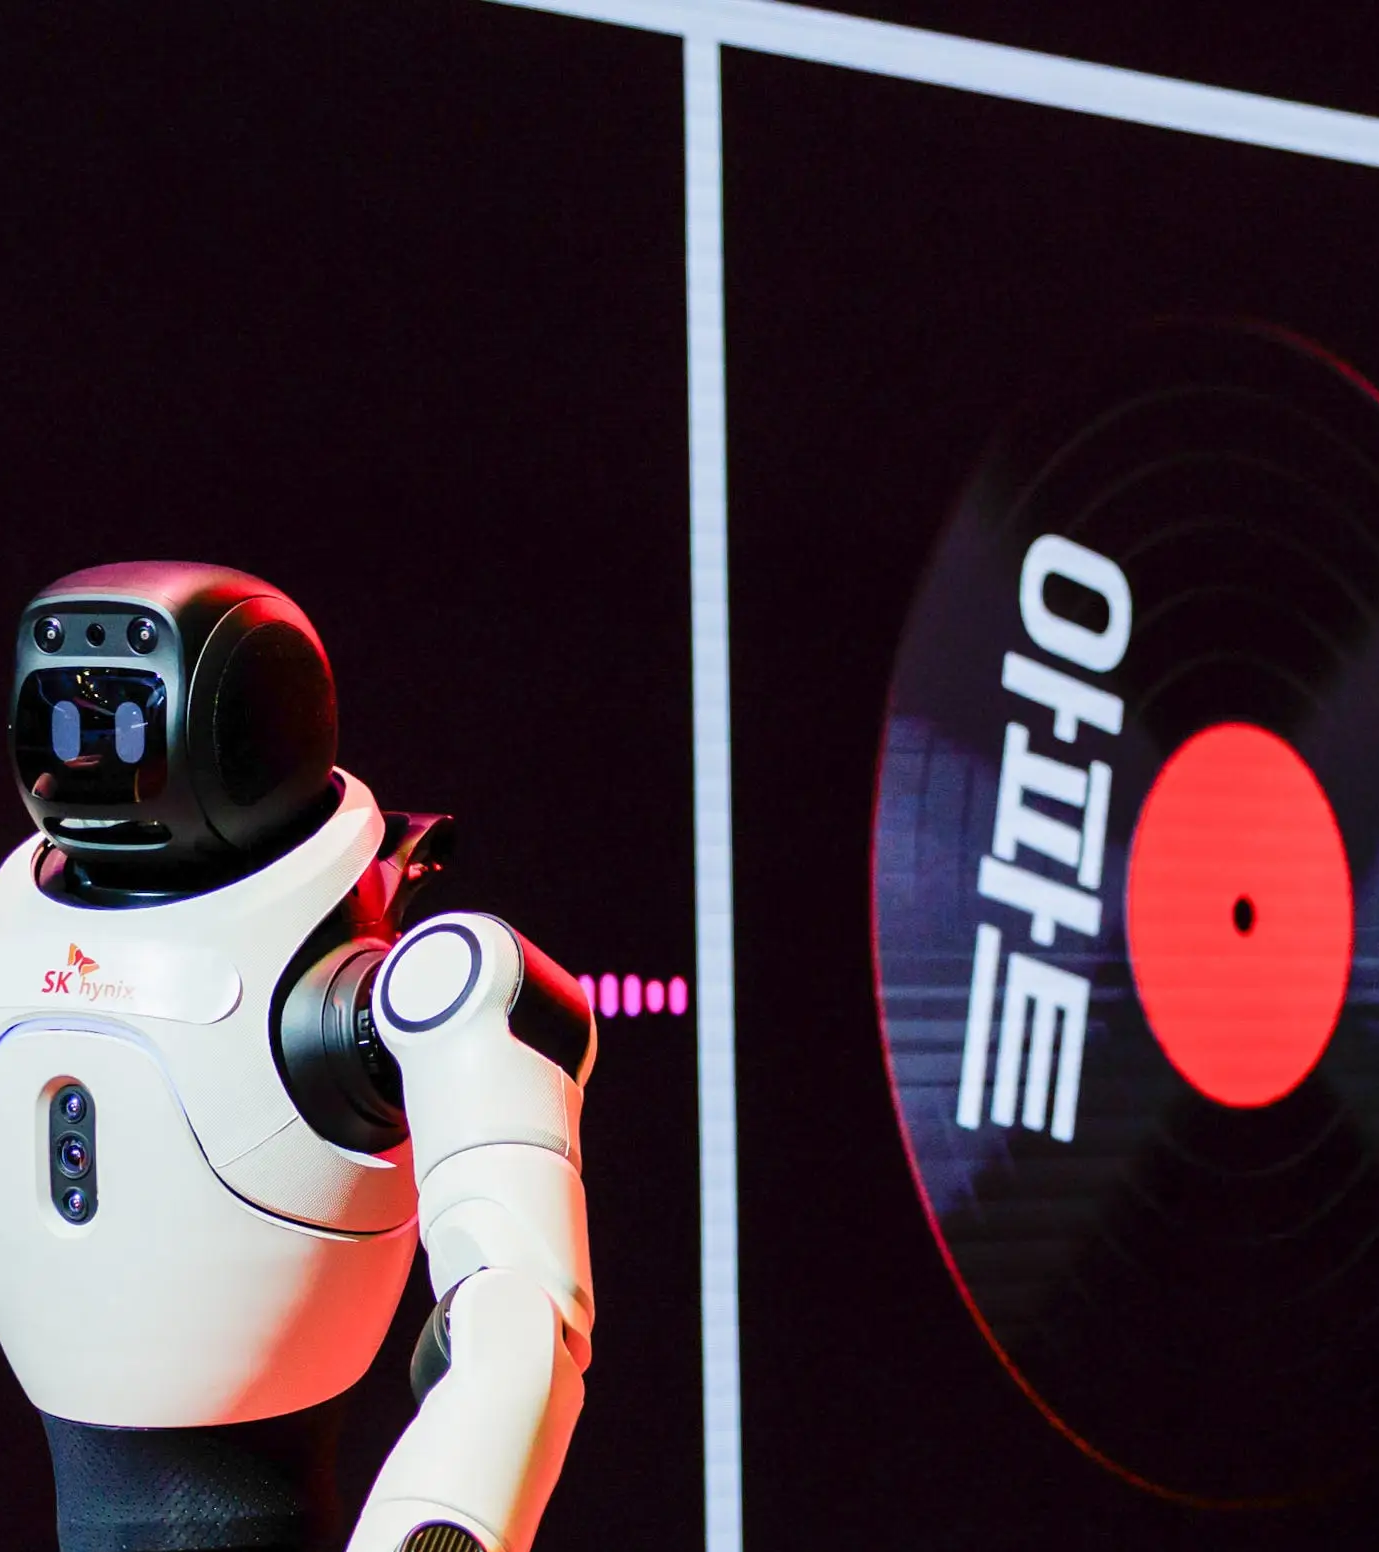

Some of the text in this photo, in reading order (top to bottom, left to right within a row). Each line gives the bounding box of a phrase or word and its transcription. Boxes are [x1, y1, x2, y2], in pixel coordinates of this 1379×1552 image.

[41, 970, 135, 1001] SK hynix
[956, 533, 1133, 1143] 아파트
